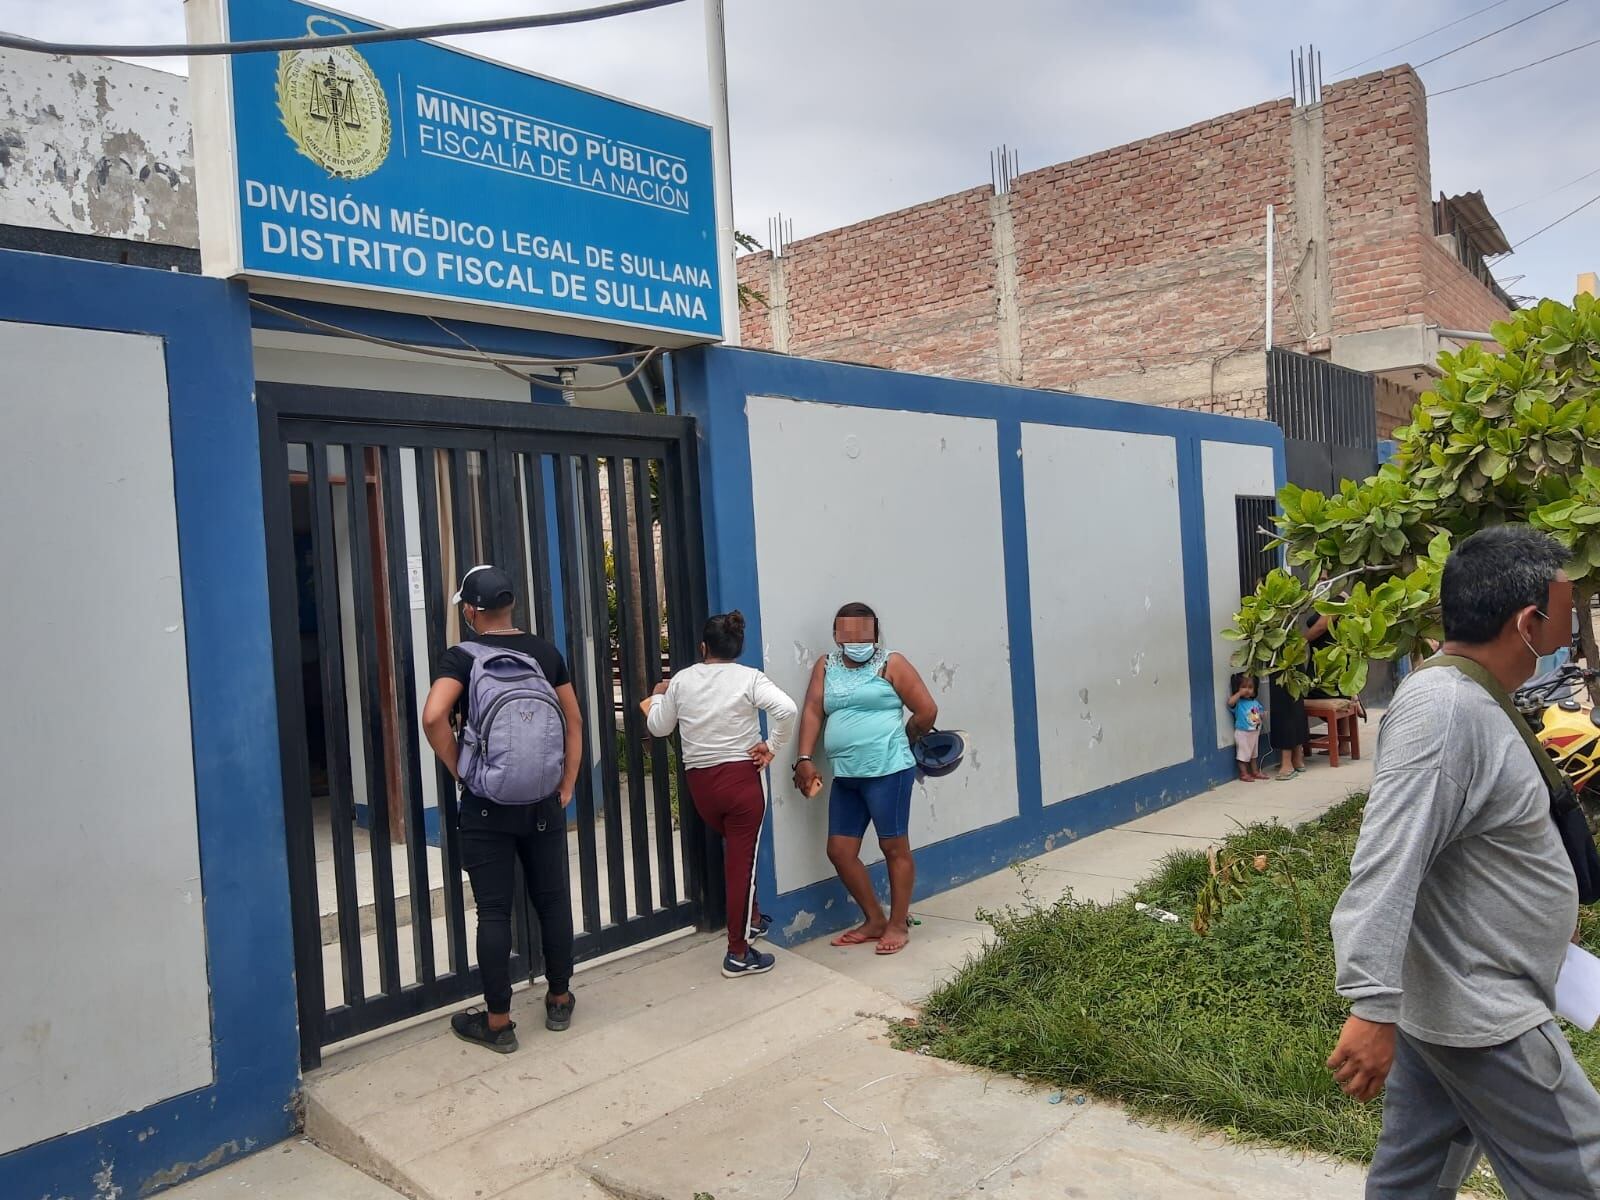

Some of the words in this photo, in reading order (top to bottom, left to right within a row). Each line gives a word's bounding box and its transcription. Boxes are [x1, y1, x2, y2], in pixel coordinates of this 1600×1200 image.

[305, 135, 345, 165] MINISTERIO
[416, 92, 578, 158] MINISTERIO
[586, 139, 688, 185] PÚBLICO
[419, 124, 535, 173] FISCALÍA
[540, 154, 572, 181] DE
[579, 164, 606, 189] LA
[611, 177, 689, 209] NACIÓN
[246, 180, 381, 229] DIVISIÓN
[390, 208, 494, 249] MÉDICO
[502, 230, 580, 264] LEGAL
[586, 245, 614, 271] DE
[620, 253, 712, 289] SULLANA
[261, 222, 427, 276] DISTRITO
[437, 252, 543, 295] FISCAL
[551, 271, 587, 301] DE
[595, 279, 707, 320] SULLANA
